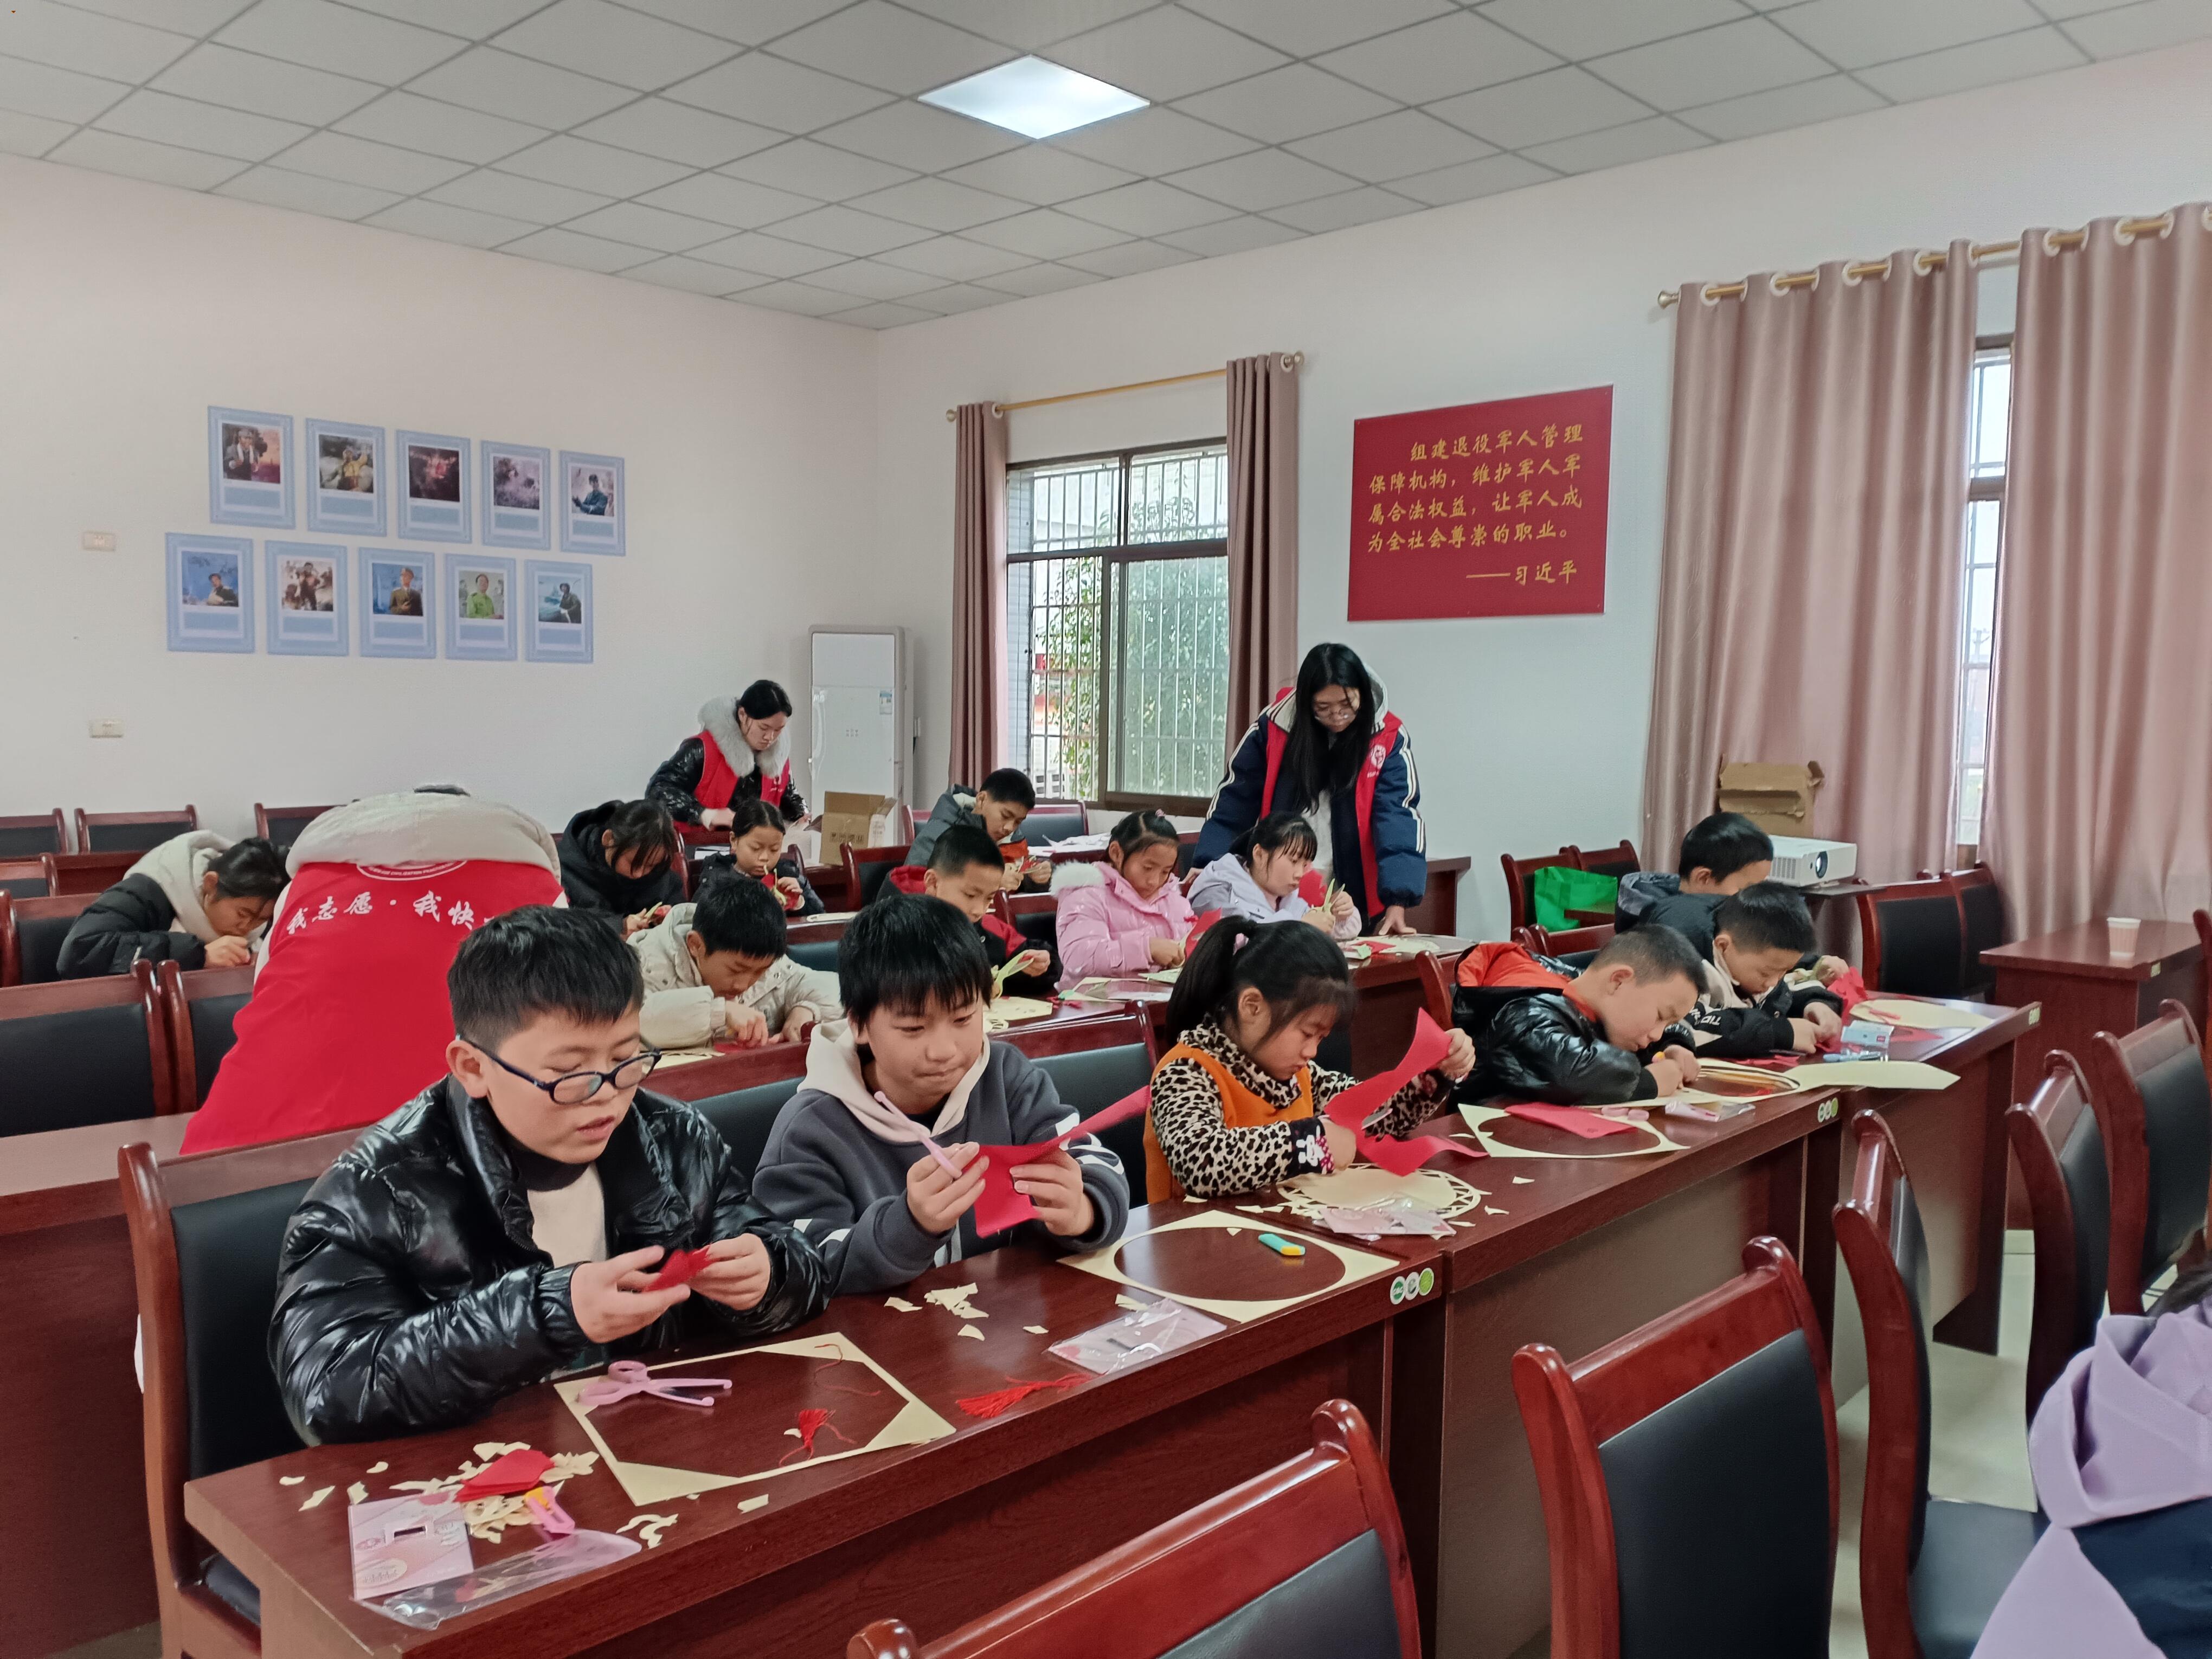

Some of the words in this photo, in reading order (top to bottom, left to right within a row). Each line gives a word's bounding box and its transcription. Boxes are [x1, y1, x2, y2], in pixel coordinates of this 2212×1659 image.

[1410, 422, 1584, 461] 组建退役军人管理
[1369, 453, 1581, 494] 保障机构，维护军人军
[1368, 484, 1583, 525] 属合法权益，让军人成
[1367, 519, 1567, 553] 为全社会尊崇的职业。
